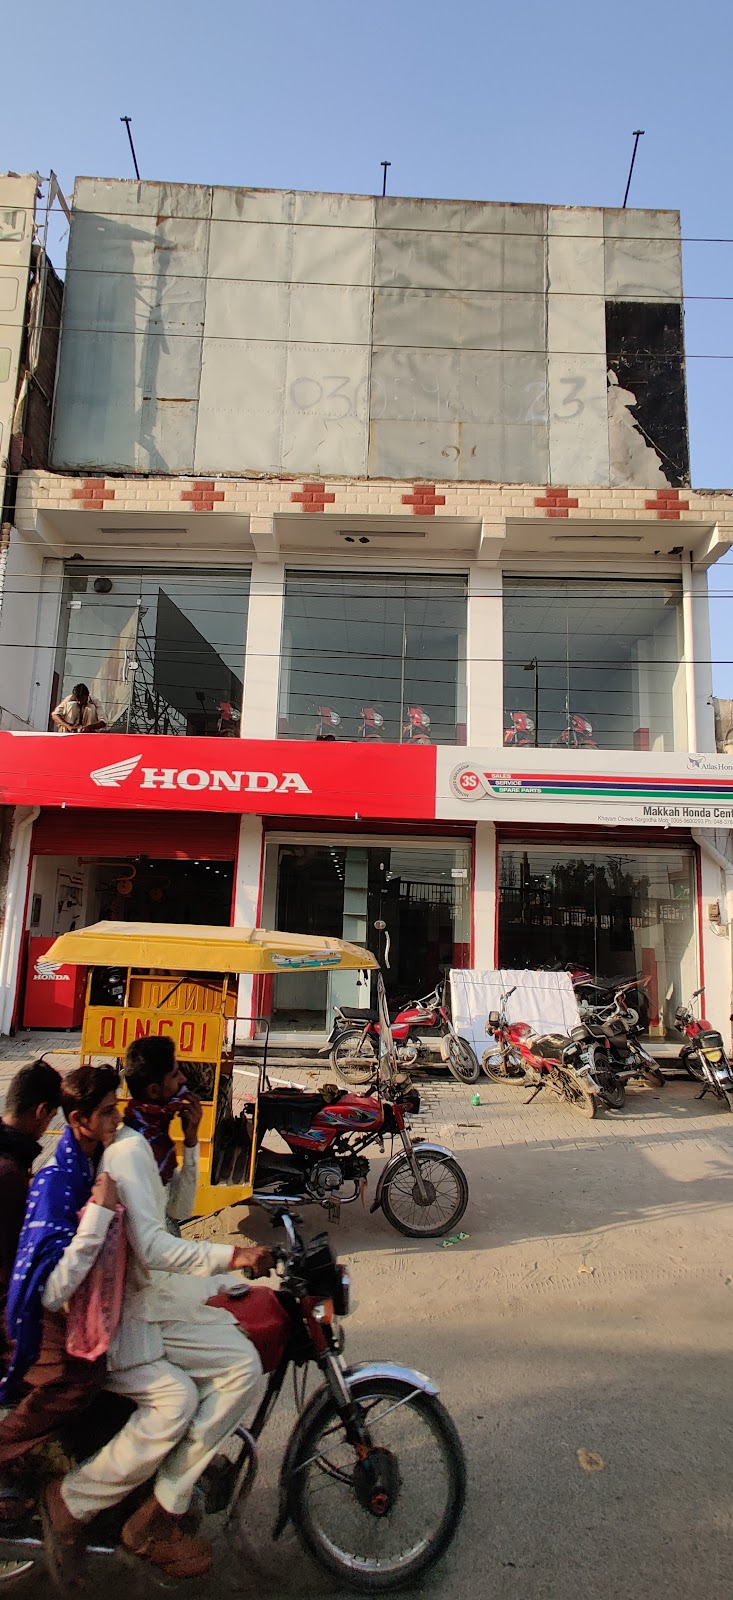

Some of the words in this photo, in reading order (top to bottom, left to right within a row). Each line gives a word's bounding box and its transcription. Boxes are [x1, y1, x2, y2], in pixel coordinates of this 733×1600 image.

[140, 768, 312, 793] HONDA
[461, 775, 478, 788] 3S
[643, 806, 680, 817] Makkah
[682, 807, 711, 818] Honda
[635, 816, 657, 824] Sargodha
